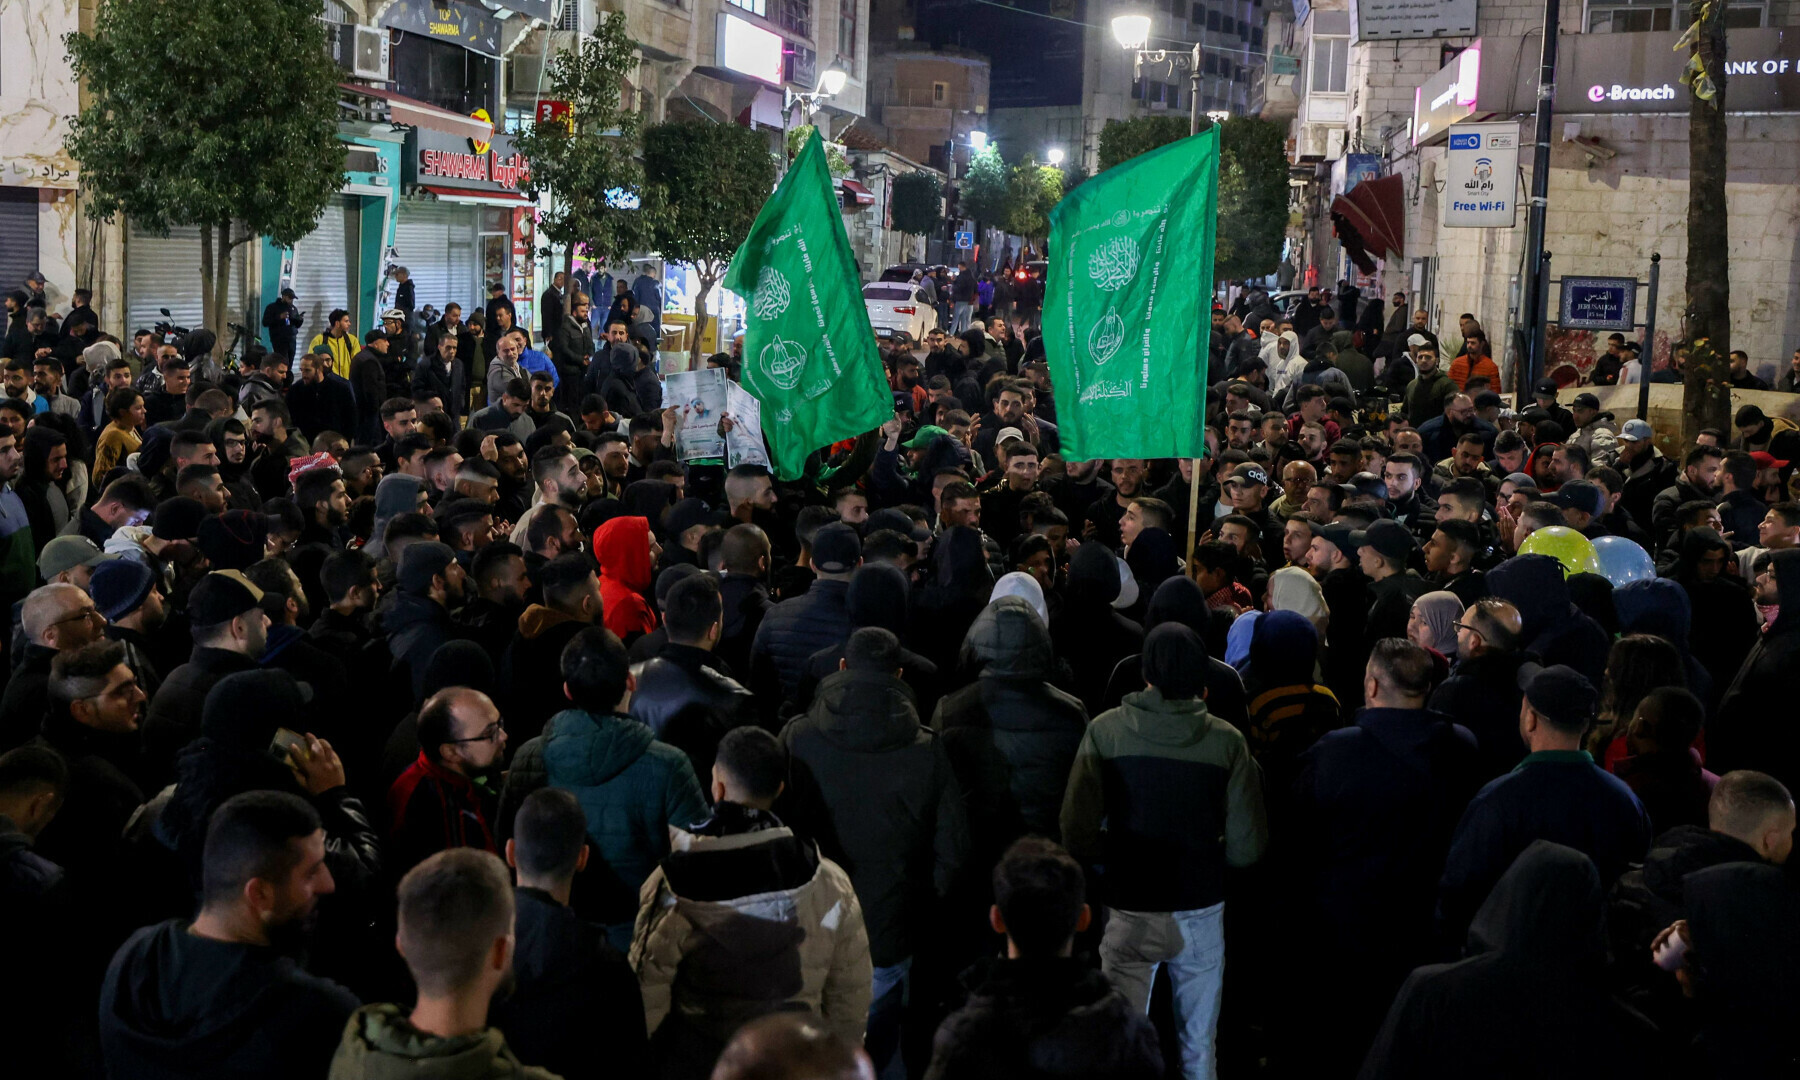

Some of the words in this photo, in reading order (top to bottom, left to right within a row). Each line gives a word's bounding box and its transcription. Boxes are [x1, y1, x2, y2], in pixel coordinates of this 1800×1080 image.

[439, 8, 451, 21] TOP
[429, 22, 460, 36] SHAWARMA
[1725, 61, 1757, 75] ANK
[1762, 60, 1789, 74] OF
[1588, 84, 1675, 102] e-Branch
[424, 149, 487, 181] SHAWARMA
[1464, 178, 1479, 189] الله
[1480, 180, 1494, 191] رام
[1453, 201, 1477, 211] Free
[1479, 201, 1505, 211] Wi-Fi
[1584, 290, 1612, 303] القدس
[1577, 303, 1617, 311] JERUSALEM
